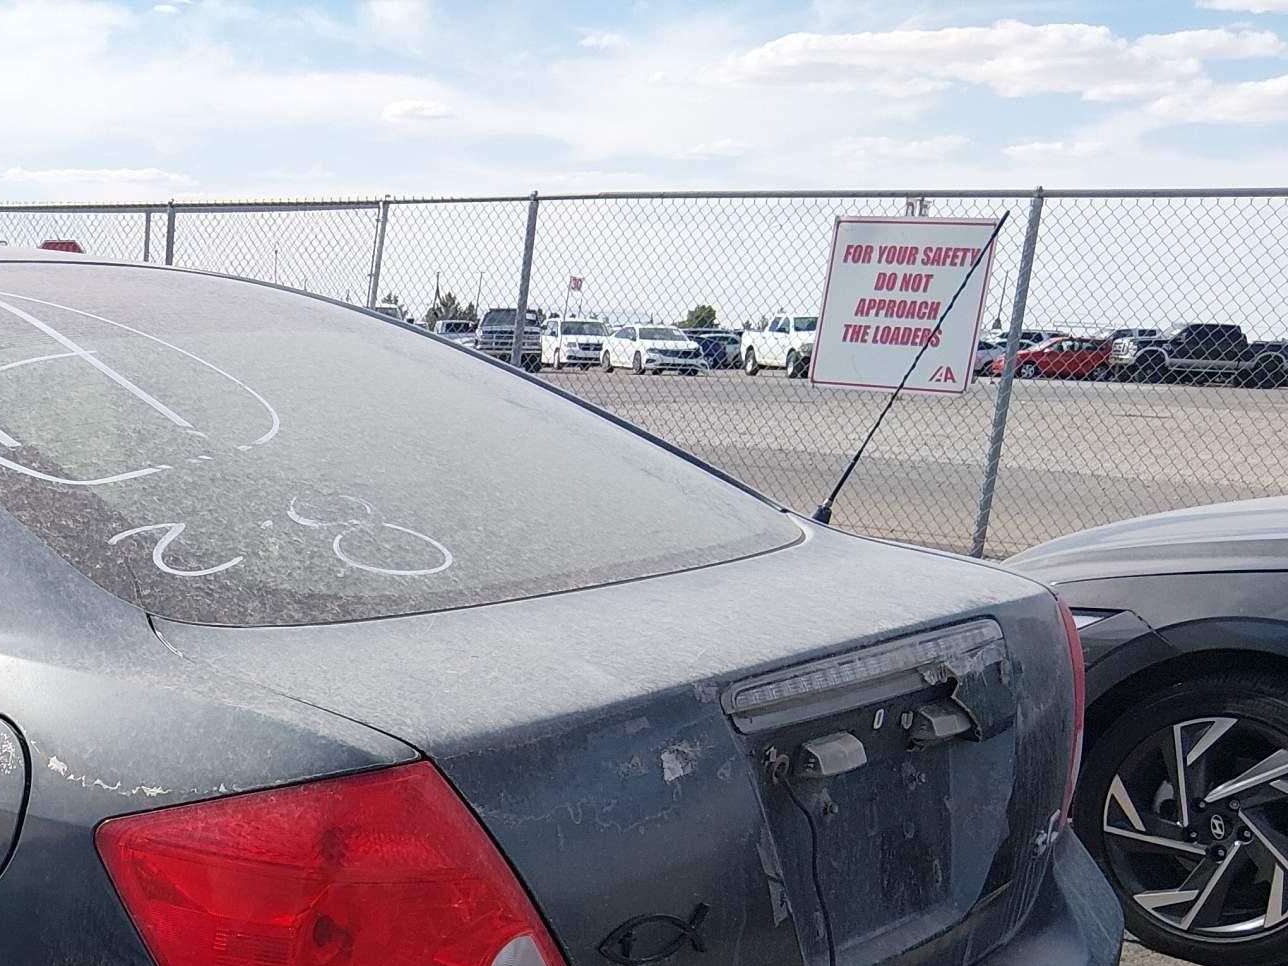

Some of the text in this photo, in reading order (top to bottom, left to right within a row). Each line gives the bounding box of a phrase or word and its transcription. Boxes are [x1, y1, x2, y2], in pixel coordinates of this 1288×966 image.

[843, 245, 981, 267] FOR YOUR SAFETY
[874, 272, 934, 292] DO NOT
[854, 298, 941, 320] APPROACH
[842, 324, 942, 347] THE LOADERS
